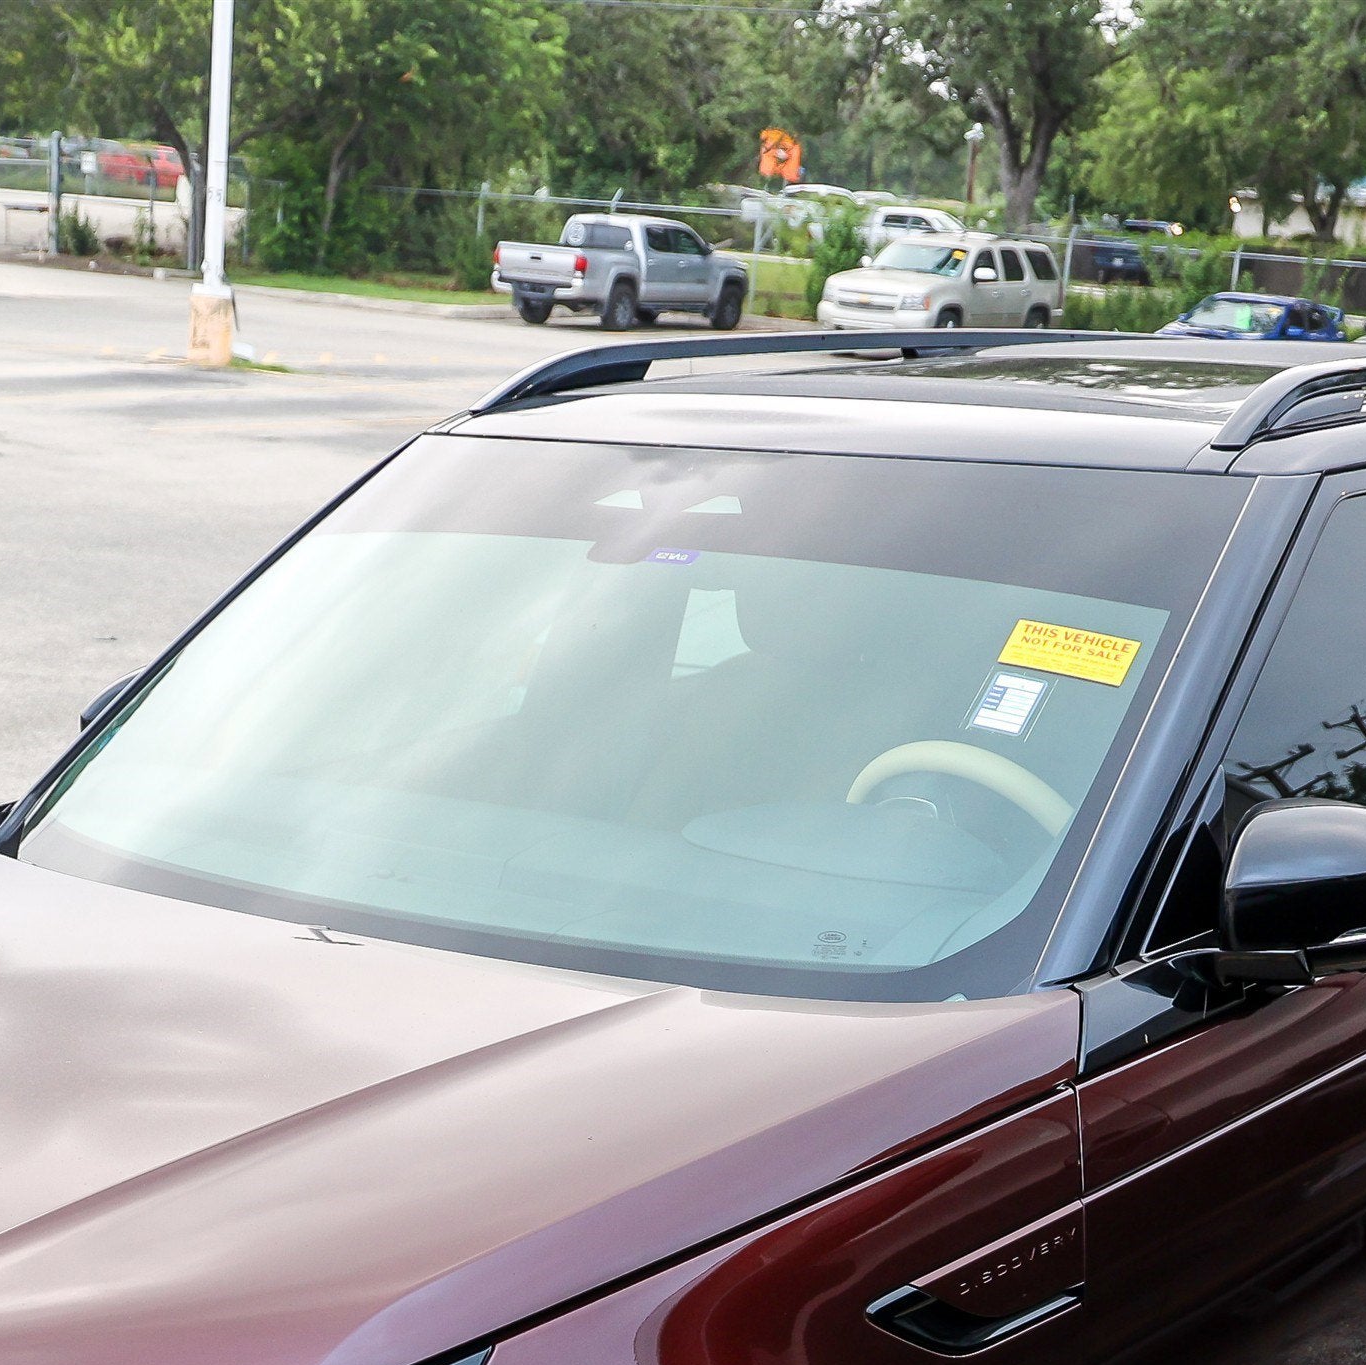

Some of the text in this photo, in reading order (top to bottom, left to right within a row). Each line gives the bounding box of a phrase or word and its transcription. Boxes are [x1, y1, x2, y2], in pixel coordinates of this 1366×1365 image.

[1021, 636, 1124, 661] NOT FOR SALE
[1023, 624, 1132, 654] THIS VEHICLE
[959, 1227, 1077, 1296] DSCOVERY
